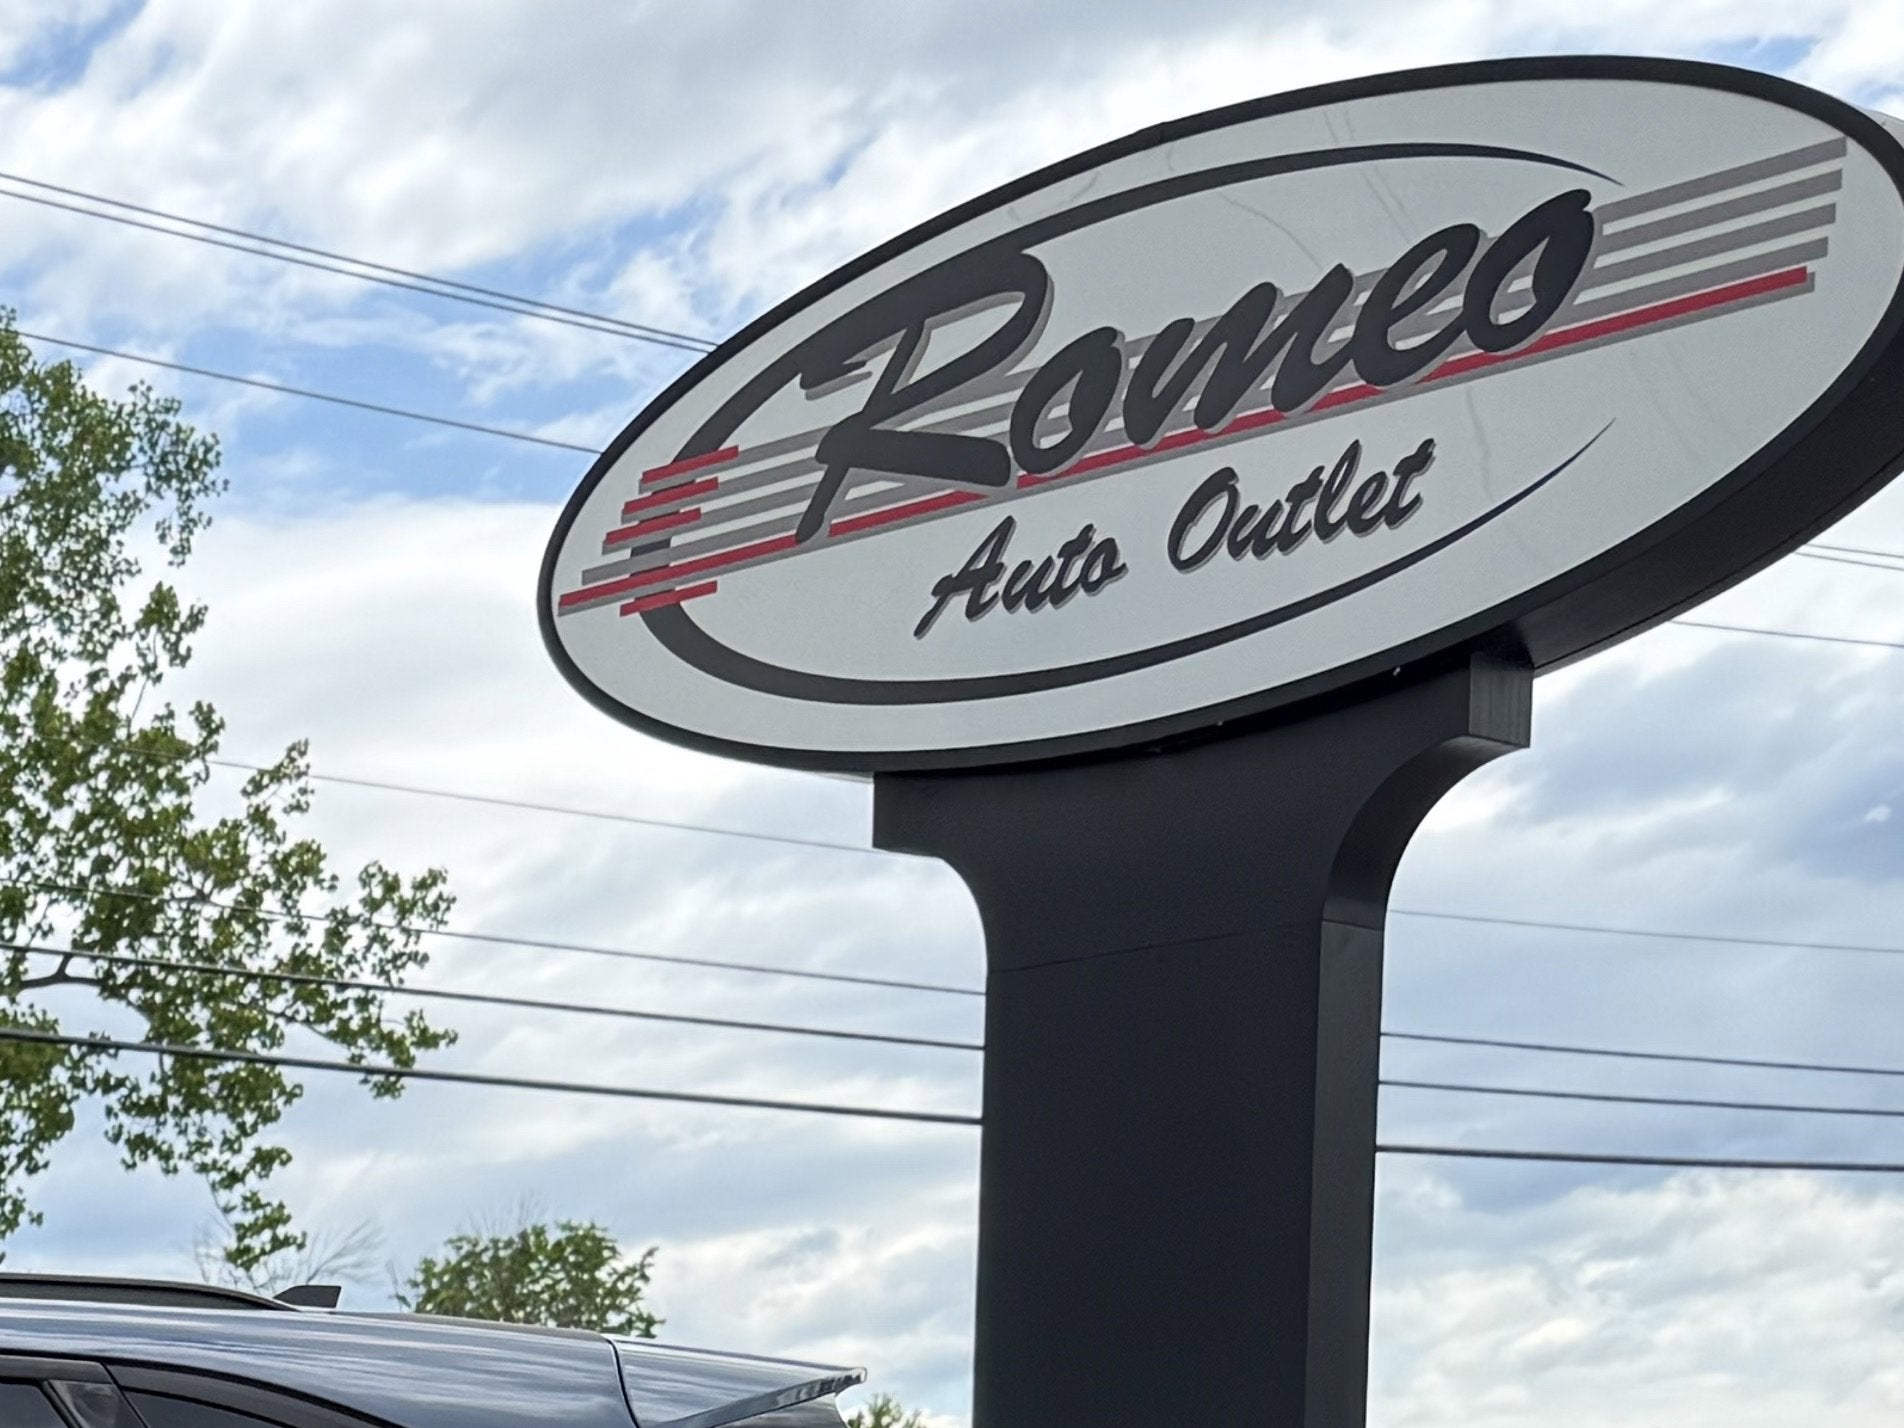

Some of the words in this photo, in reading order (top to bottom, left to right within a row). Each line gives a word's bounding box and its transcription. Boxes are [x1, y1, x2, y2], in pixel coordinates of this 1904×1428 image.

[795, 188, 1595, 543] Romeo
[913, 514, 1129, 640] Auto
[1167, 437, 1436, 574] Outlet
